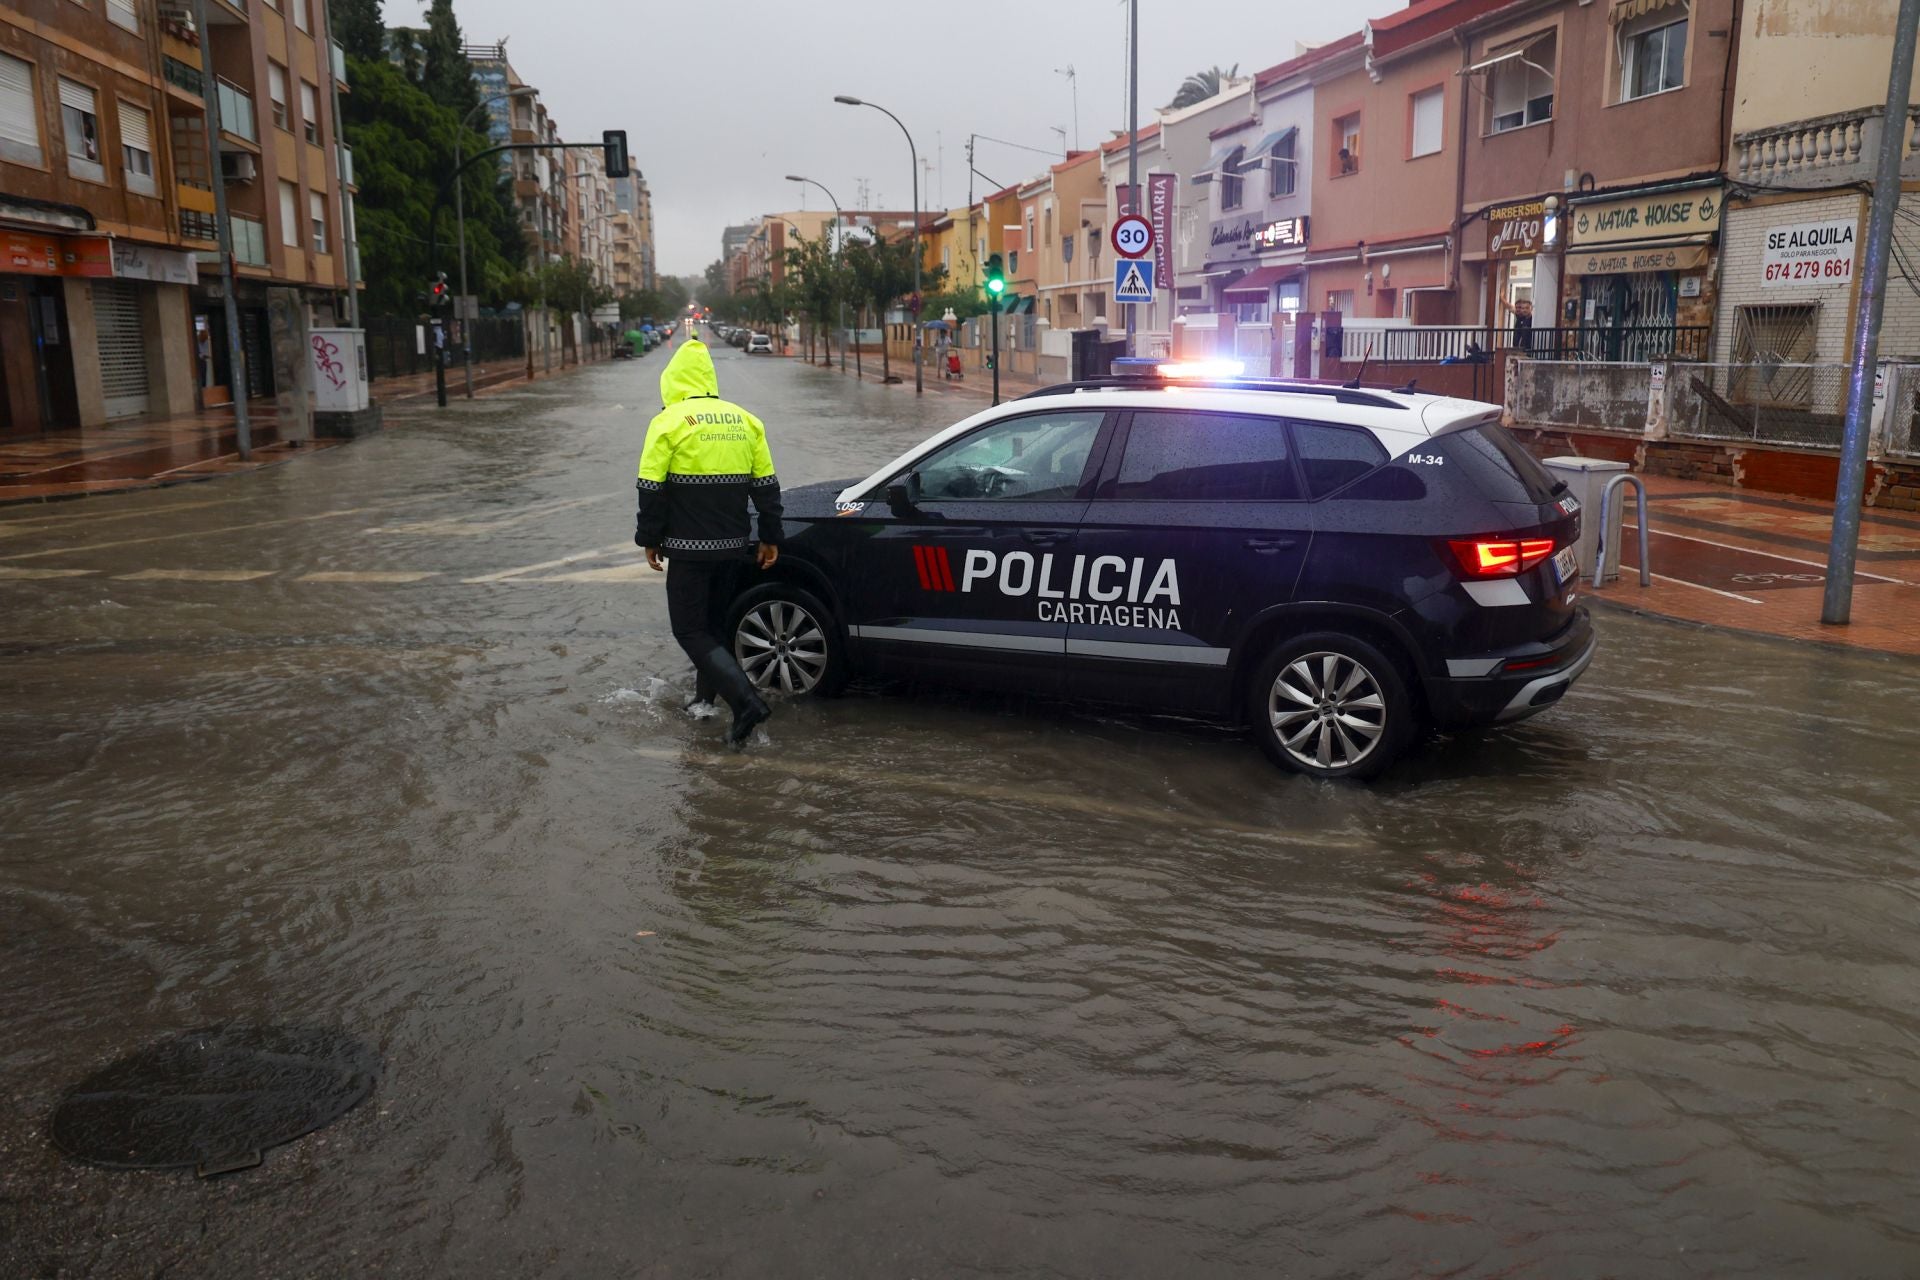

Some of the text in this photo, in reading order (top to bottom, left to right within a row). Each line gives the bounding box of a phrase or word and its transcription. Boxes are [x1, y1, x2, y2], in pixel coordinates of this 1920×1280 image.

[1490, 202, 1546, 220] BARBERSHO
[1595, 202, 1693, 232] NATUR HOUSE
[1120, 229, 1145, 244] 30
[1768, 226, 1853, 249] SE ALQUILA
[1780, 248, 1838, 258] SOLO PARA NEGOCIO
[1599, 254, 1664, 271] NATUR HOUSE
[1766, 258, 1851, 281] 674 279 661
[696, 413, 744, 424] POLICIA
[700, 433, 747, 441] CARTAGENA
[1408, 453, 1444, 466] M-34
[841, 502, 865, 511] 092
[961, 549, 1181, 606] POLICIA
[1038, 600, 1182, 631] CARTAGENA
